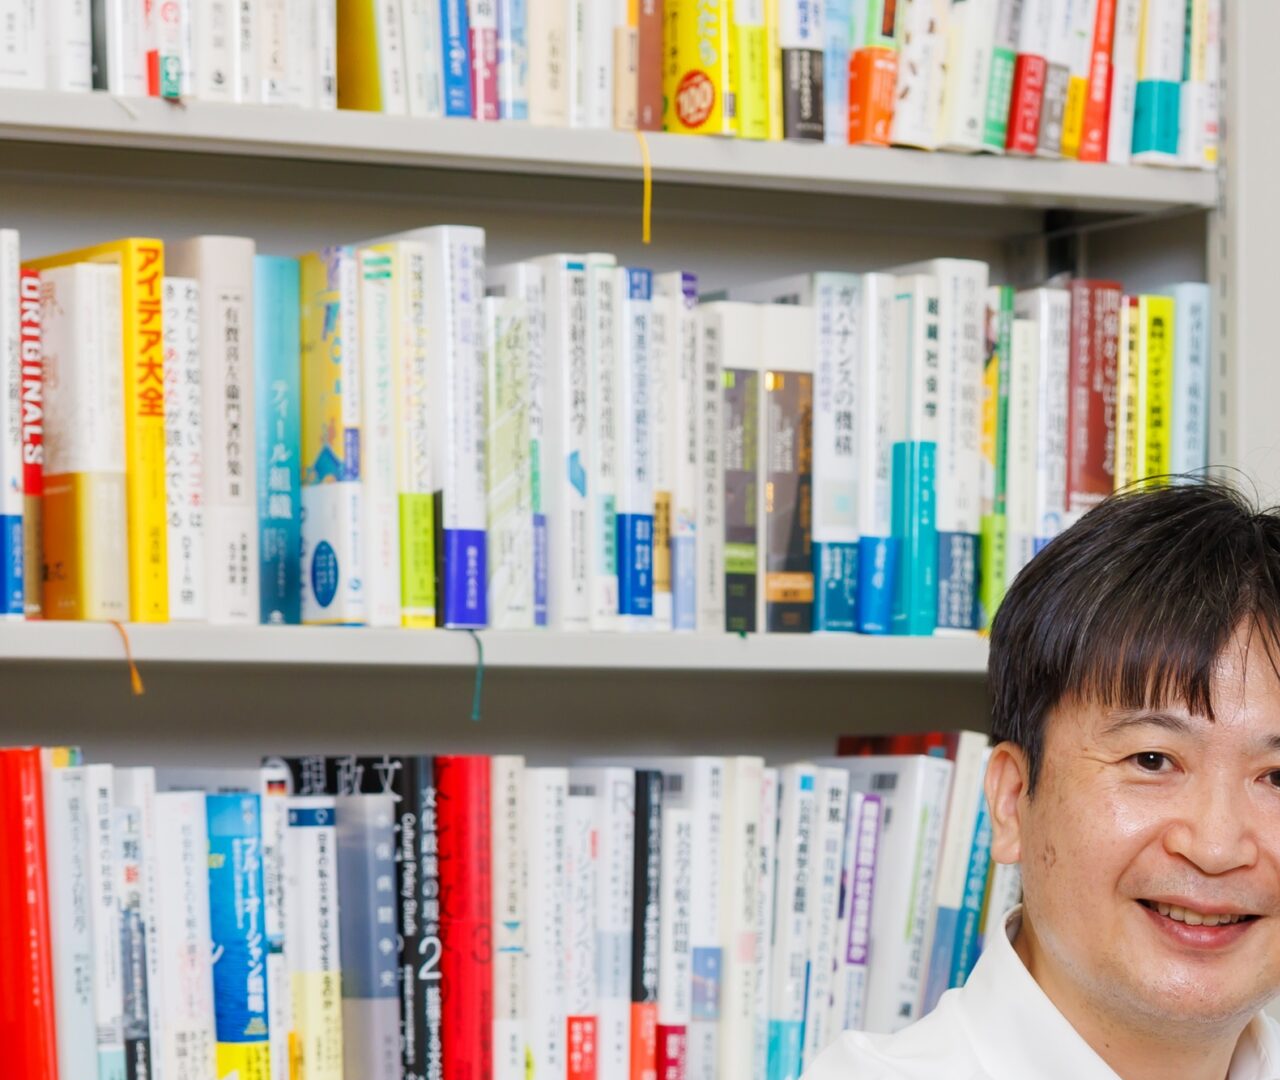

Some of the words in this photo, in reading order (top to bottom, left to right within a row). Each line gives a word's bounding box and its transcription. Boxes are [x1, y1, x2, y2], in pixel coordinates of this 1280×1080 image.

[21, 276, 44, 465] ORIGINALS
[137, 247, 164, 418] アイデア大全
[834, 285, 857, 457] ガバナンスの機構
[268, 379, 293, 520] ティール組織
[402, 812, 416, 861] Cultural
[613, 781, 635, 815] R
[418, 936, 442, 981] 2
